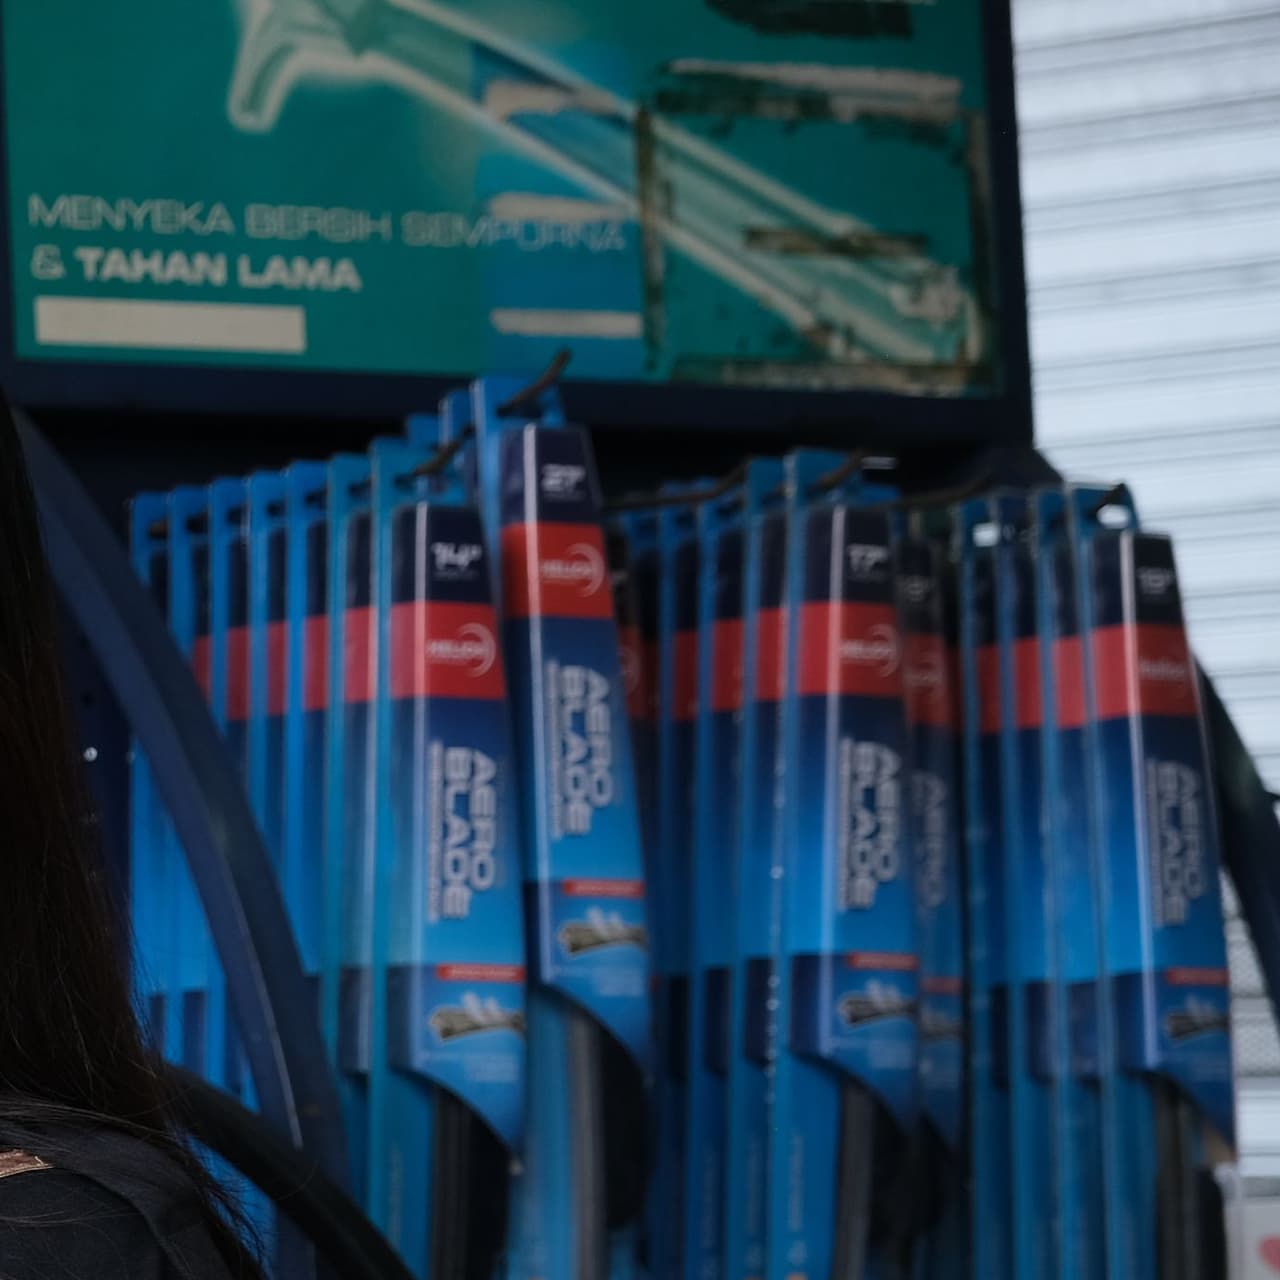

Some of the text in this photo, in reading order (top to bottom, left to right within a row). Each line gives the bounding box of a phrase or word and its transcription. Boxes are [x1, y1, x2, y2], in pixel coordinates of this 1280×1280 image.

[29, 194, 234, 236] MENYEKA
[245, 204, 391, 241] BERSIH
[75, 247, 226, 285] TAHAN
[238, 254, 362, 291] LAMA
